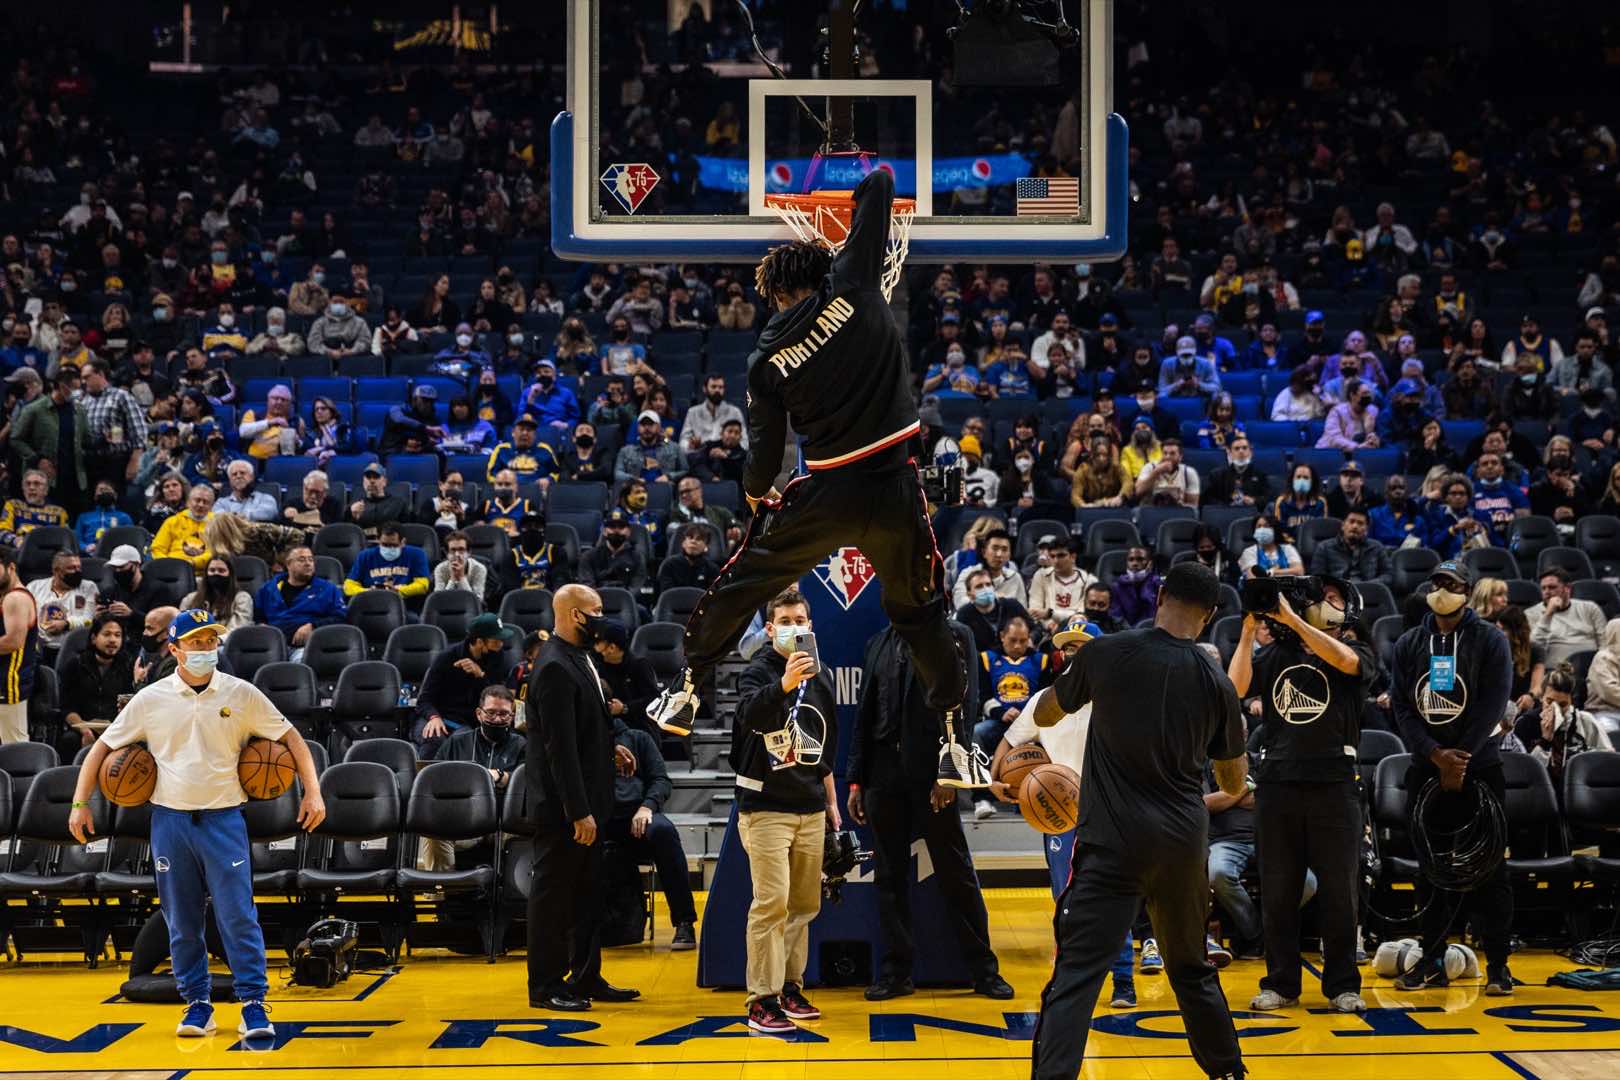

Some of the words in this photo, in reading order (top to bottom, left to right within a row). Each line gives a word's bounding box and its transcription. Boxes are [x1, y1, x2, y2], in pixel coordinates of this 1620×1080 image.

[635, 171, 647, 187] 75
[852, 556, 866, 574] 75
[190, 610, 209, 624] W
